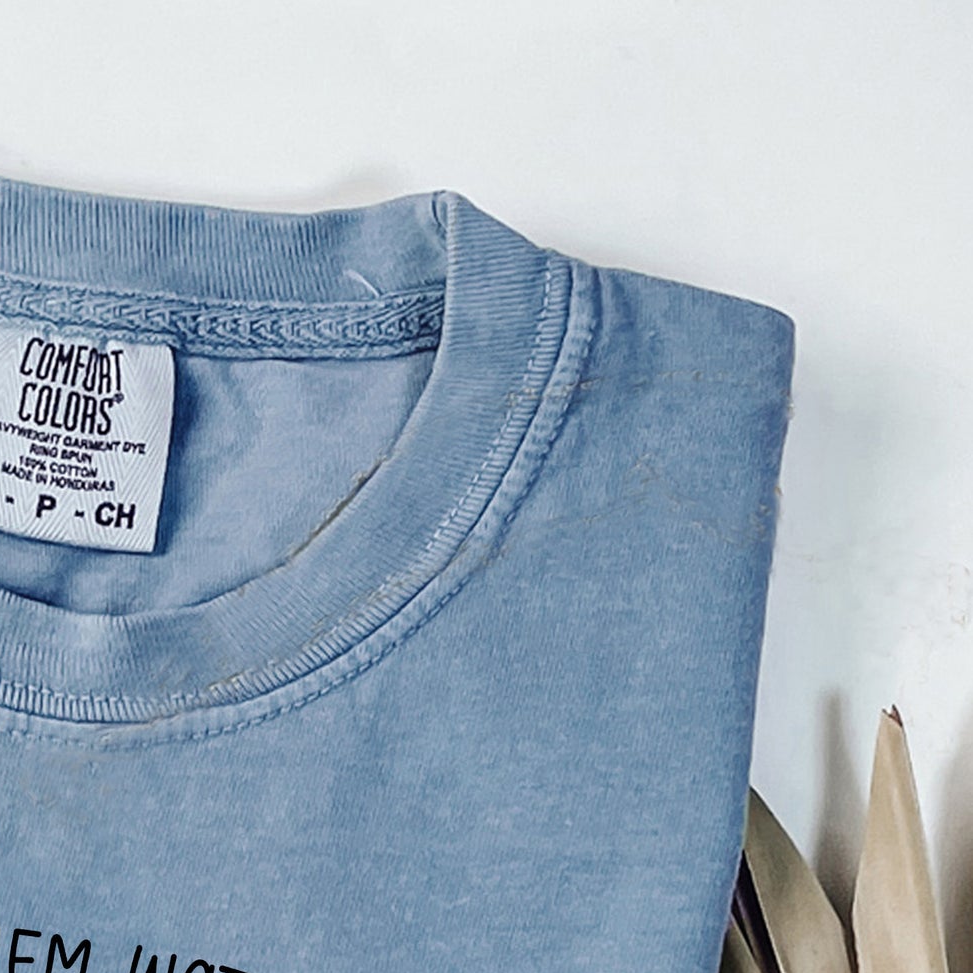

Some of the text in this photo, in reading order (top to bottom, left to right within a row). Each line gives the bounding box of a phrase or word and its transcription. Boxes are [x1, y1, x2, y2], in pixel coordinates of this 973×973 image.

[19, 337, 124, 394] COMFORT
[29, 444, 93, 465] RING SPUN
[63, 437, 121, 452] GARMENT
[123, 441, 146, 455] DYE
[1, 462, 116, 492] MADE IN HONDURAS
[19, 456, 99, 478] 100% COTTON
[35, 495, 57, 518] P
[94, 502, 136, 529] CH
